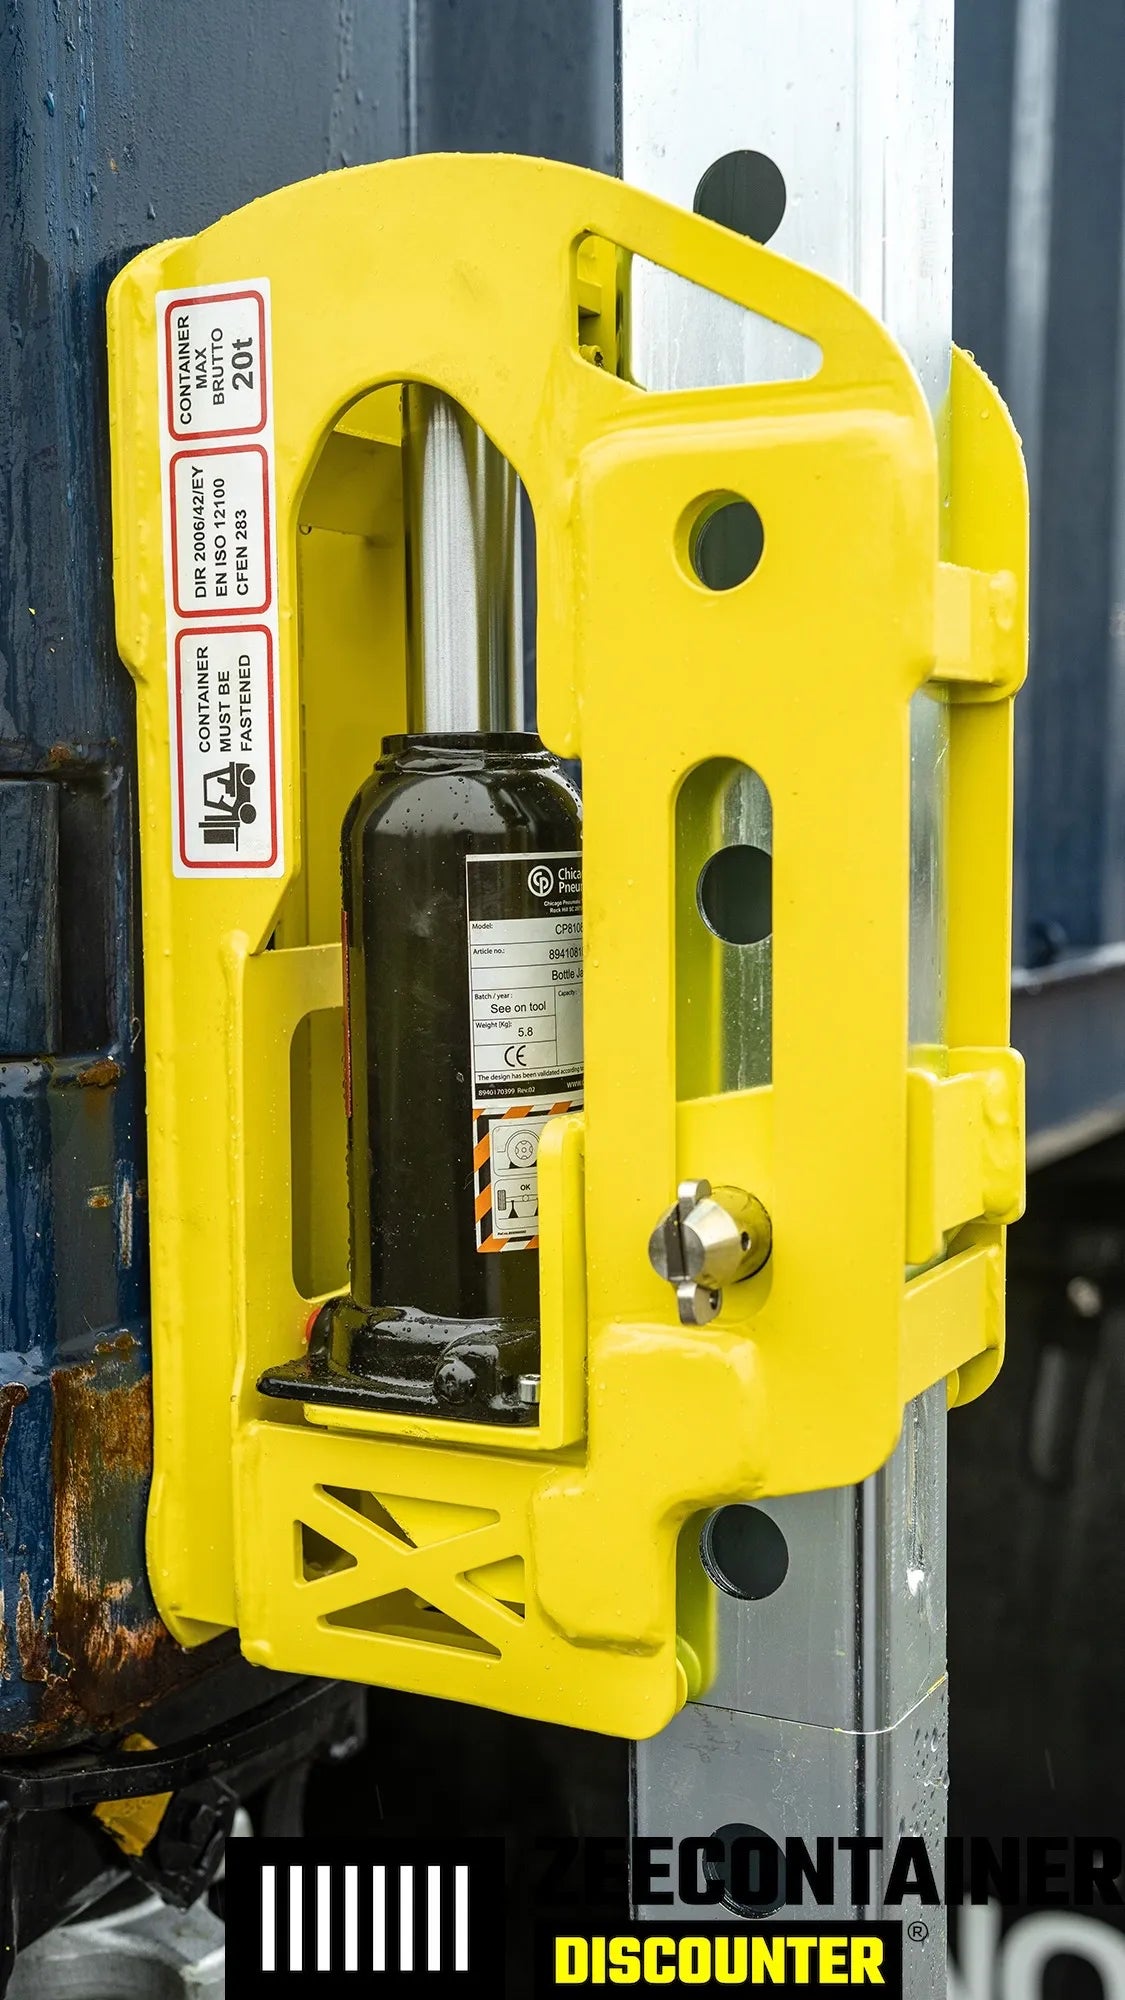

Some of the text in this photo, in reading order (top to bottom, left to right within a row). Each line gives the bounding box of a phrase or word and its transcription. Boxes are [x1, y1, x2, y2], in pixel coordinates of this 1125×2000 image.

[177, 315, 192, 425] CONTAINER
[195, 347, 208, 389] MAX
[211, 328, 225, 405] BRUTTO
[231, 337, 254, 391] 20t
[191, 465, 207, 598] DIR 2006/42/EY
[213, 478, 228, 597] EN ISO 12100
[235, 509, 249, 595] CFEN 283
[197, 646, 211, 753] CONTAINER
[217, 670, 232, 752] MUST BE
[238, 654, 252, 751] FASTENED
[552, 969, 575, 980] Bottle
[475, 1021, 497, 1029] Weight
[490, 1001, 547, 1014] See on tool
[518, 1026, 533, 1037] 5.8
[490, 1073, 511, 1081] design
[537, 1068, 560, 1077] validated
[504, 1045, 527, 1067] CE
[520, 1183, 531, 1191] OK
